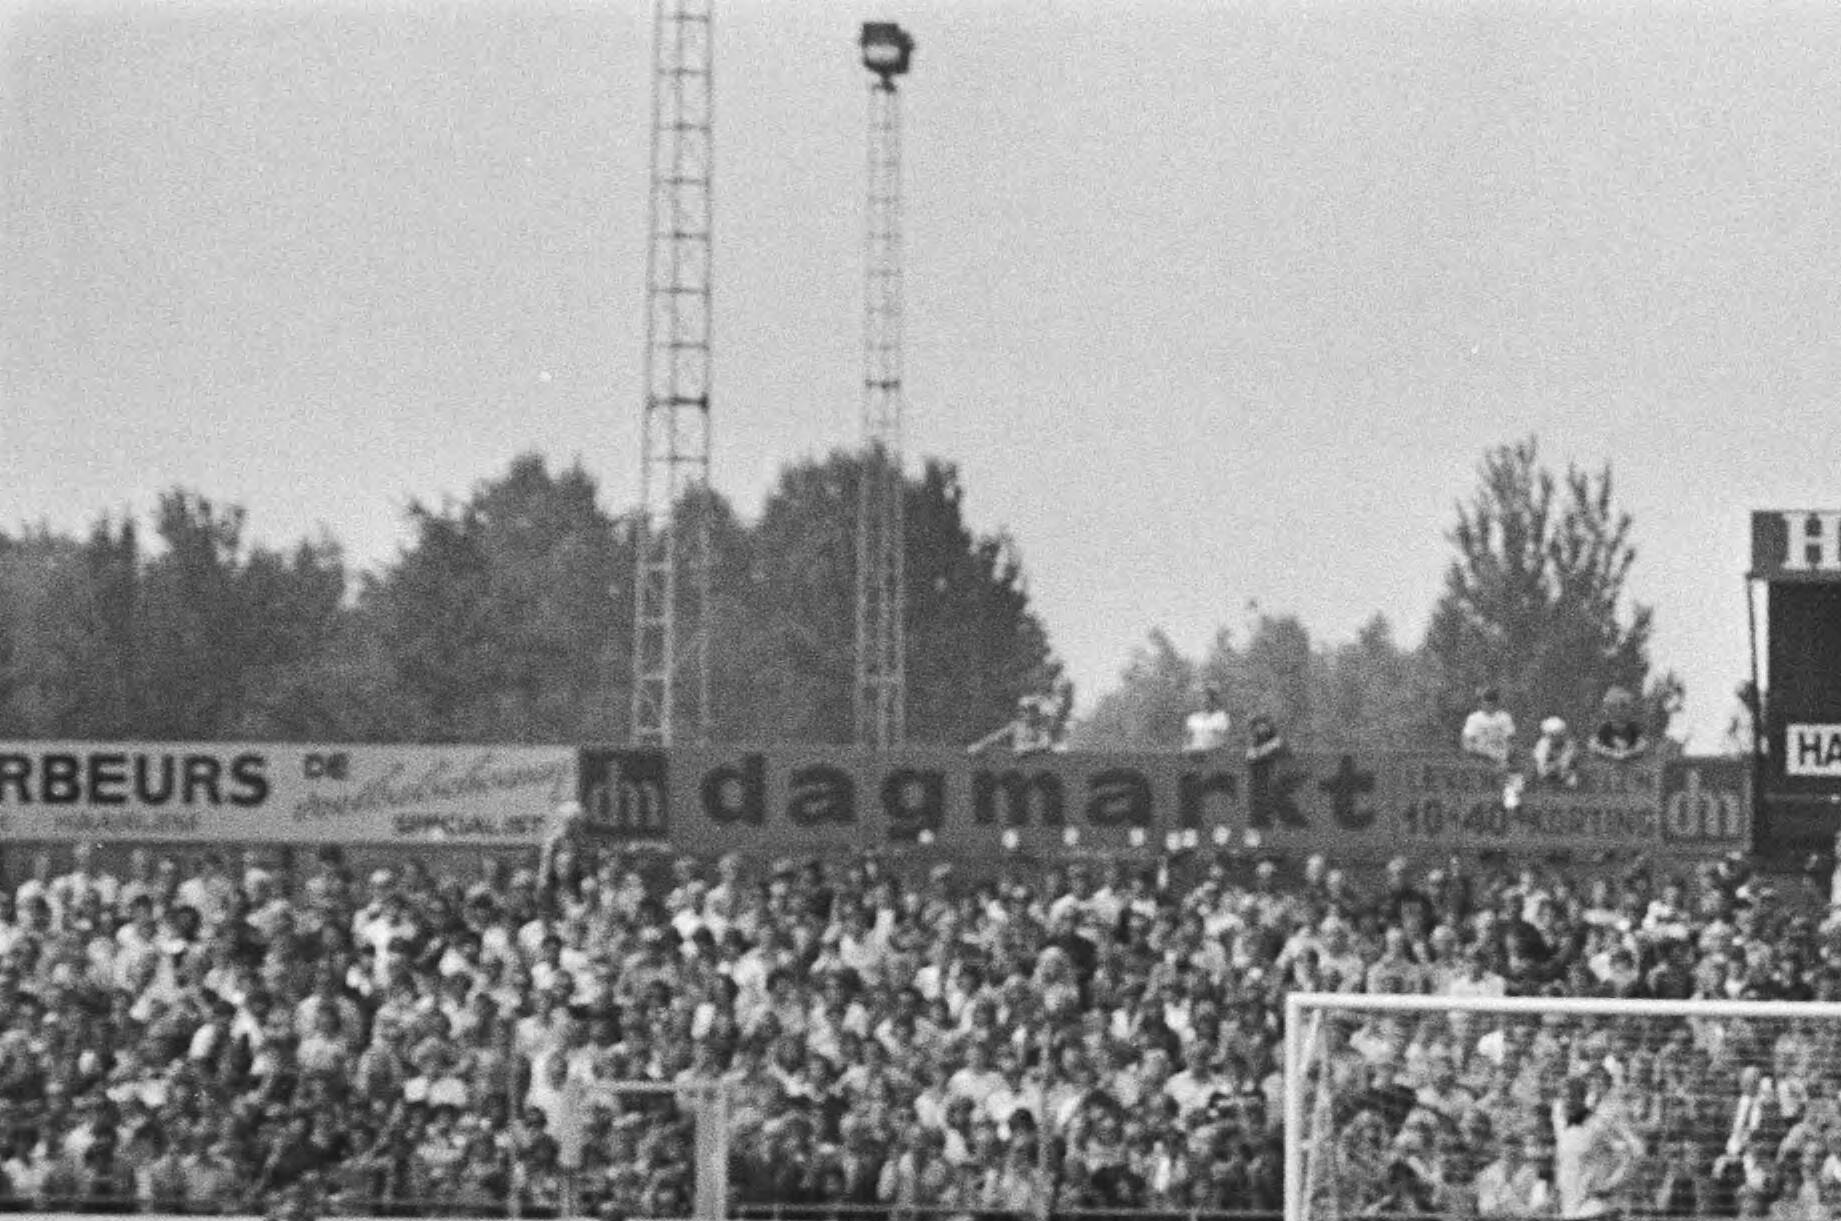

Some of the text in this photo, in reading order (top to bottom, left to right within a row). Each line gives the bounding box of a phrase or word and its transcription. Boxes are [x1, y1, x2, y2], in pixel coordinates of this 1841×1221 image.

[0, 753, 270, 806] RBEURS
[700, 753, 1377, 843] dagmarkt
[1667, 768, 1746, 837] dm
